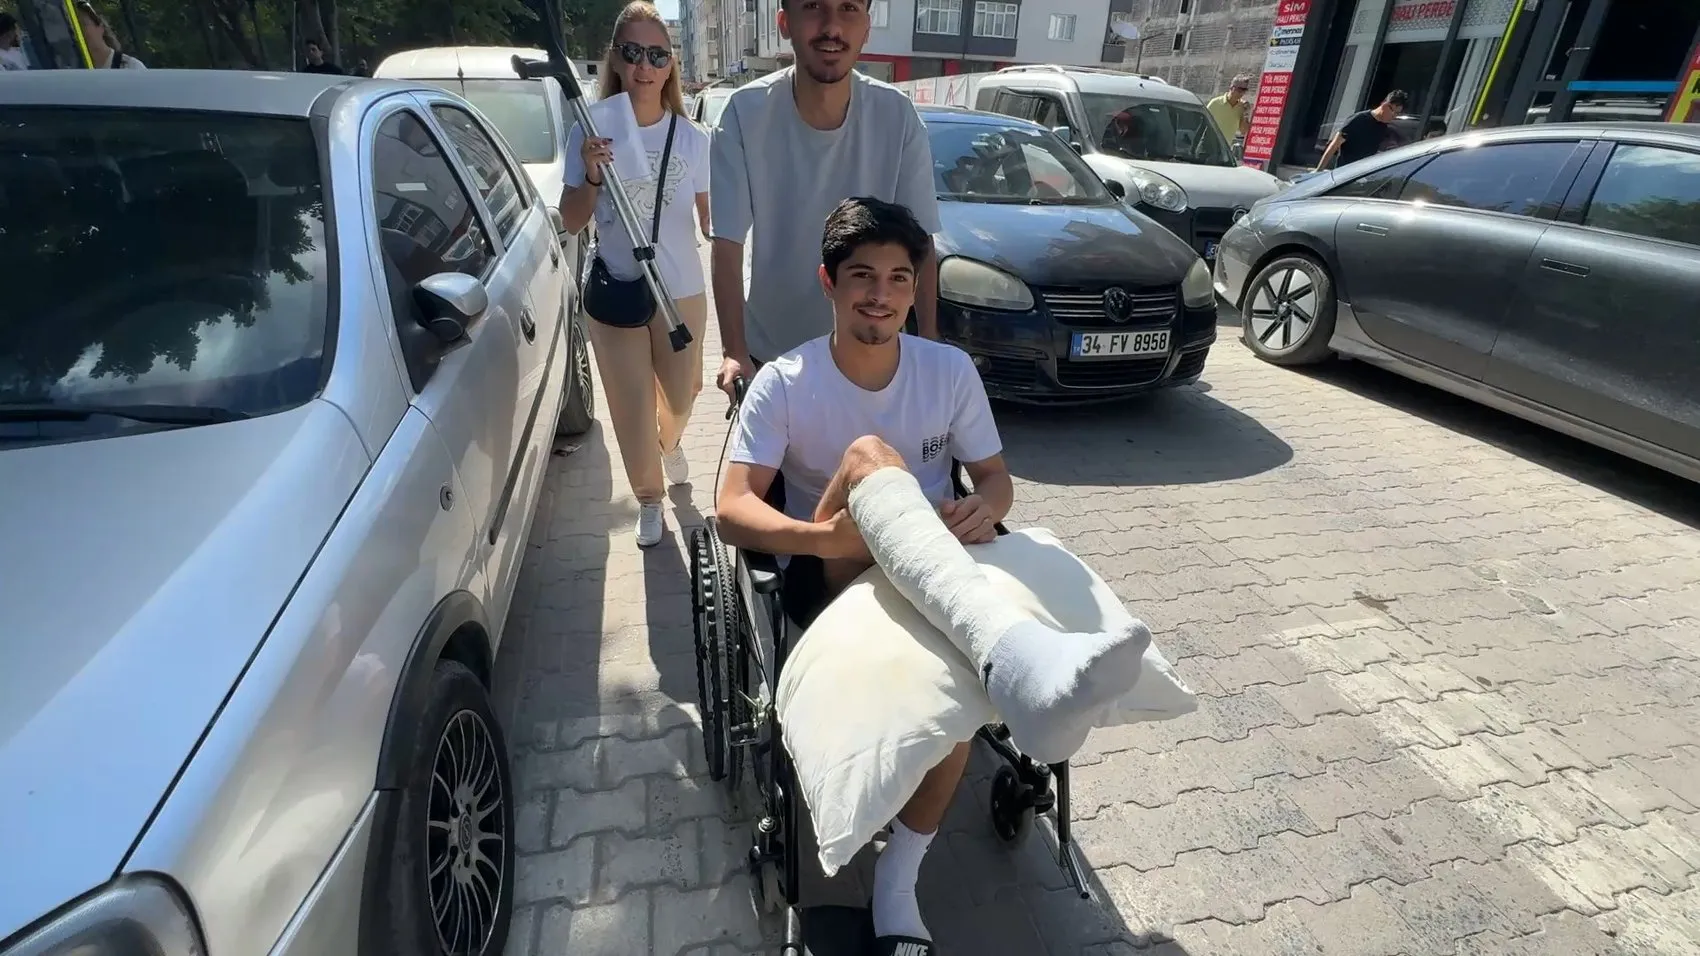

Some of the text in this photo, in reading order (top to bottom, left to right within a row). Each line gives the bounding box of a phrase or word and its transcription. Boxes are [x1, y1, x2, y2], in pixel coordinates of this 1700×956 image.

[1418, 0, 1454, 18] PERDE
[1289, 13, 1307, 23] PERDE
[1273, 75, 1288, 84] PERDE
[1271, 86, 1286, 94] PERDE
[1270, 96, 1284, 104] PERDE
[1082, 335, 1101, 353] 34
[1110, 334, 1129, 353] FV
[1133, 332, 1167, 352] 8958
[893, 942, 929, 956] NIKE
